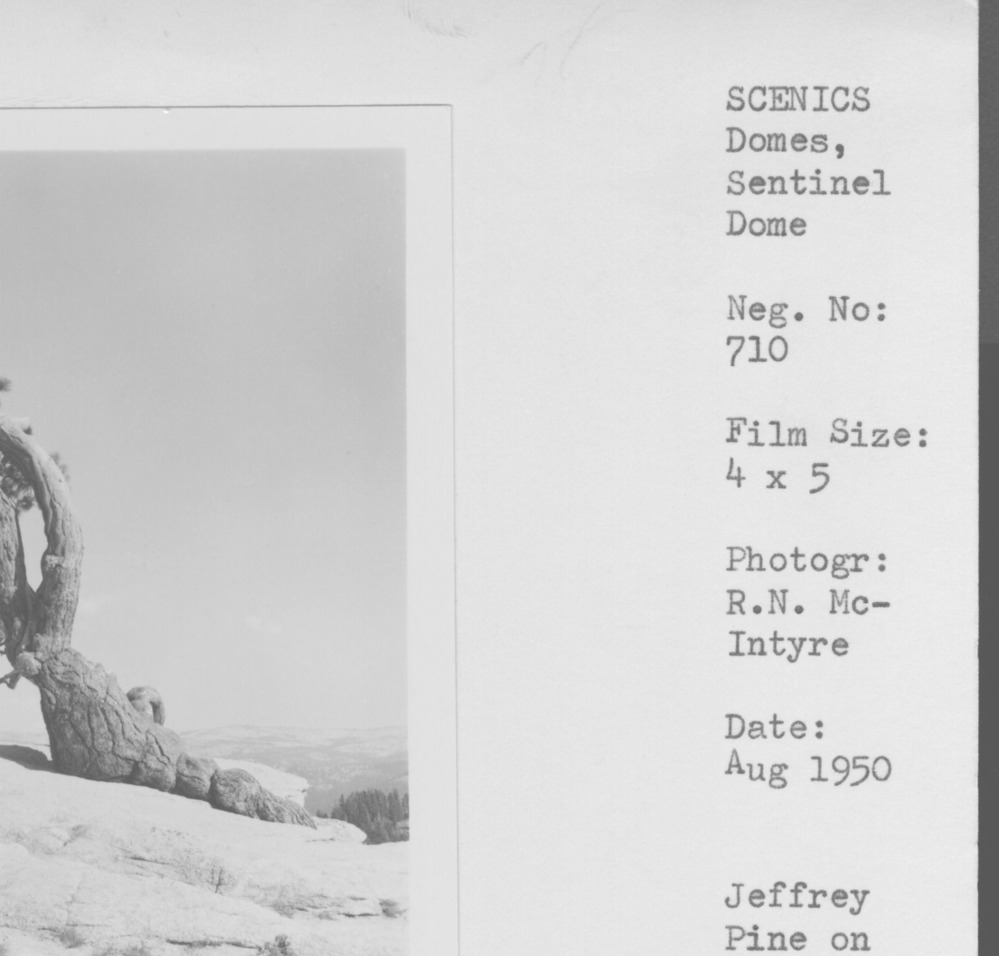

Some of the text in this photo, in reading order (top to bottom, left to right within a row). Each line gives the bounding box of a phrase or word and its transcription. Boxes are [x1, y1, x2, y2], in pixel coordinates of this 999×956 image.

[725, 85, 871, 113] SCENICS
[725, 126, 845, 160] Domes,
[726, 168, 892, 196] Sentinel
[725, 209, 807, 238] Dome
[727, 294, 887, 330] Neg. No:
[725, 334, 789, 367] 710
[725, 416, 928, 448] Film Size:
[725, 456, 831, 495] 4 x 5
[725, 545, 887, 580] Photogr:
[726, 588, 891, 616] R.N. Mc-
[728, 630, 850, 664] Intyre
[724, 713, 824, 740] Date:
[724, 748, 893, 790] Aug 1950
[724, 880, 871, 916] Jeffrey
[724, 923, 872, 952] Pine on
